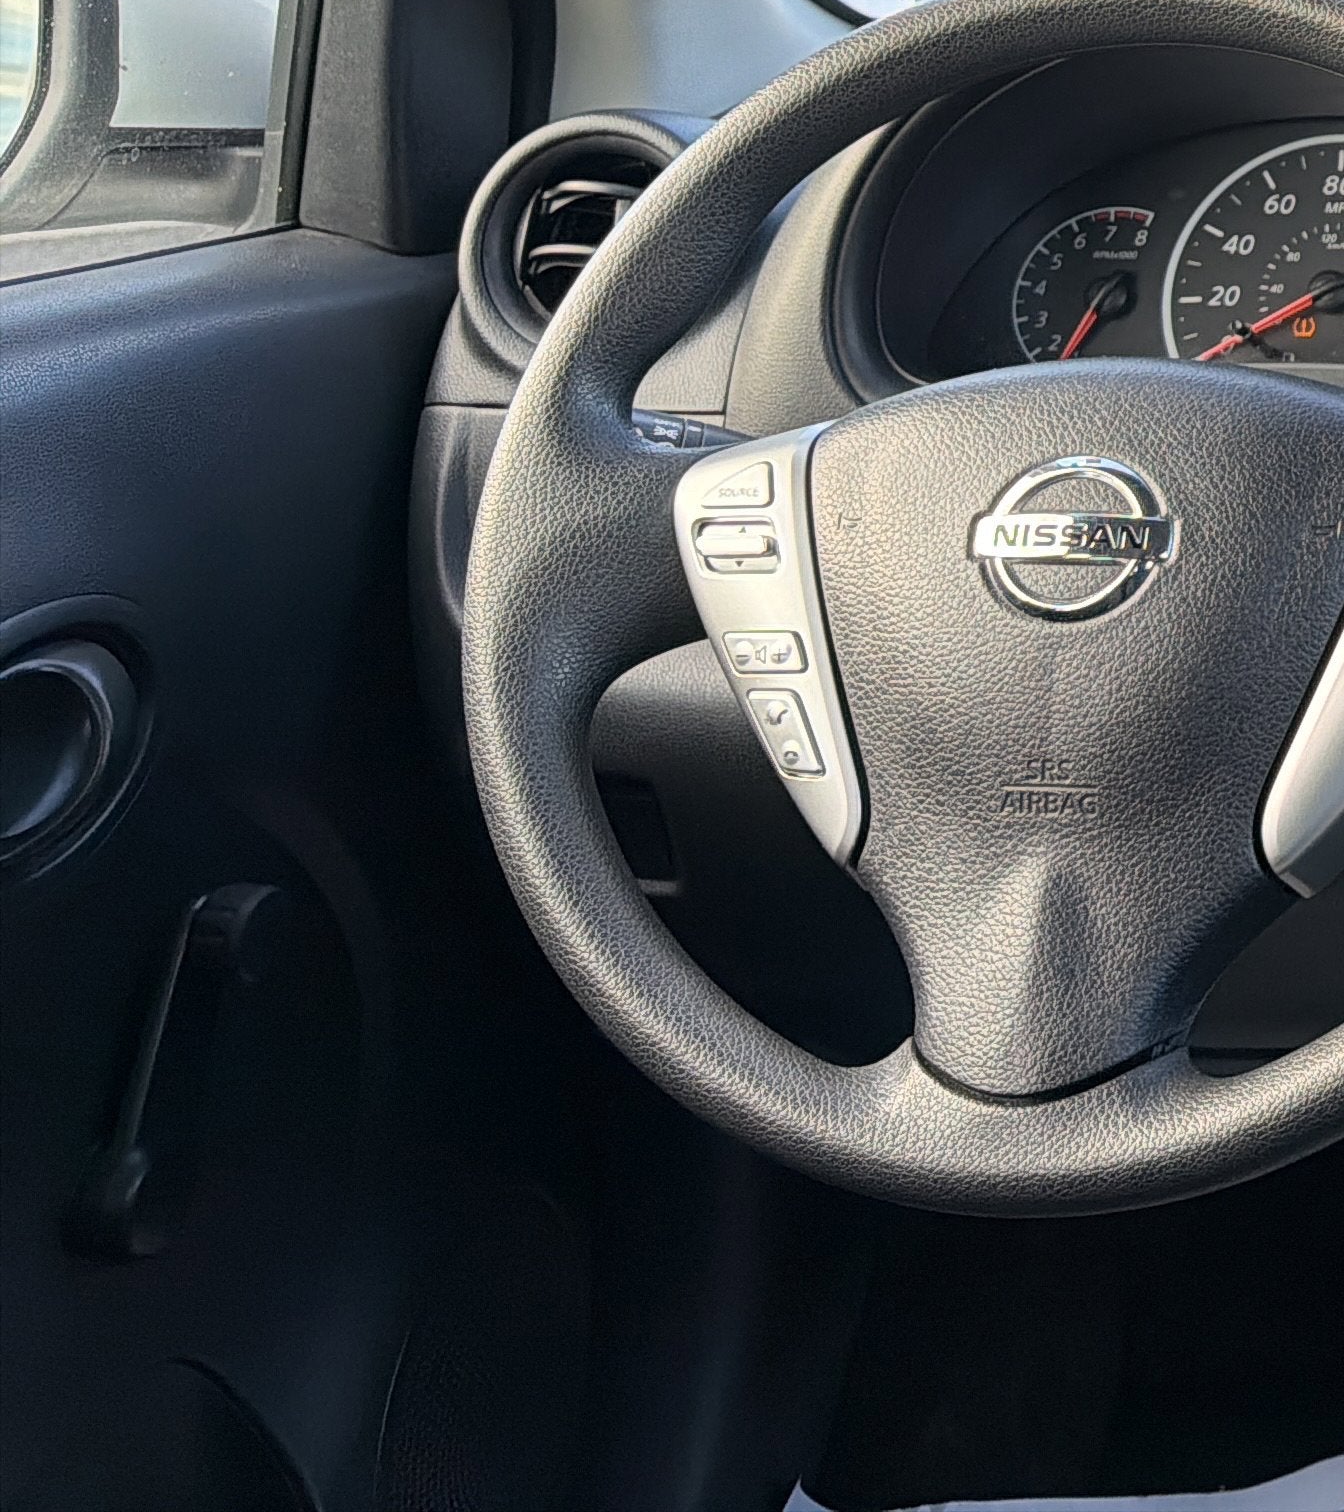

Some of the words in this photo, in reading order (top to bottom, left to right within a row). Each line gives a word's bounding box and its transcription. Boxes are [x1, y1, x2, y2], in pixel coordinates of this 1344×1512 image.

[1263, 193, 1297, 215] 60
[1073, 232, 1087, 250] 6
[1105, 225, 1118, 242] 7
[1134, 229, 1149, 246] 8
[1222, 234, 1256, 256] 40
[1050, 253, 1064, 270] 5
[1033, 280, 1047, 296] 4
[1207, 285, 1241, 307] 20
[1269, 283, 1284, 294] 40
[1034, 310, 1048, 328] 3
[1048, 334, 1062, 351] 2
[993, 523, 1150, 550] NISSAN
[1025, 758, 1075, 781] SRS
[1000, 791, 1102, 815] AIRBAG
